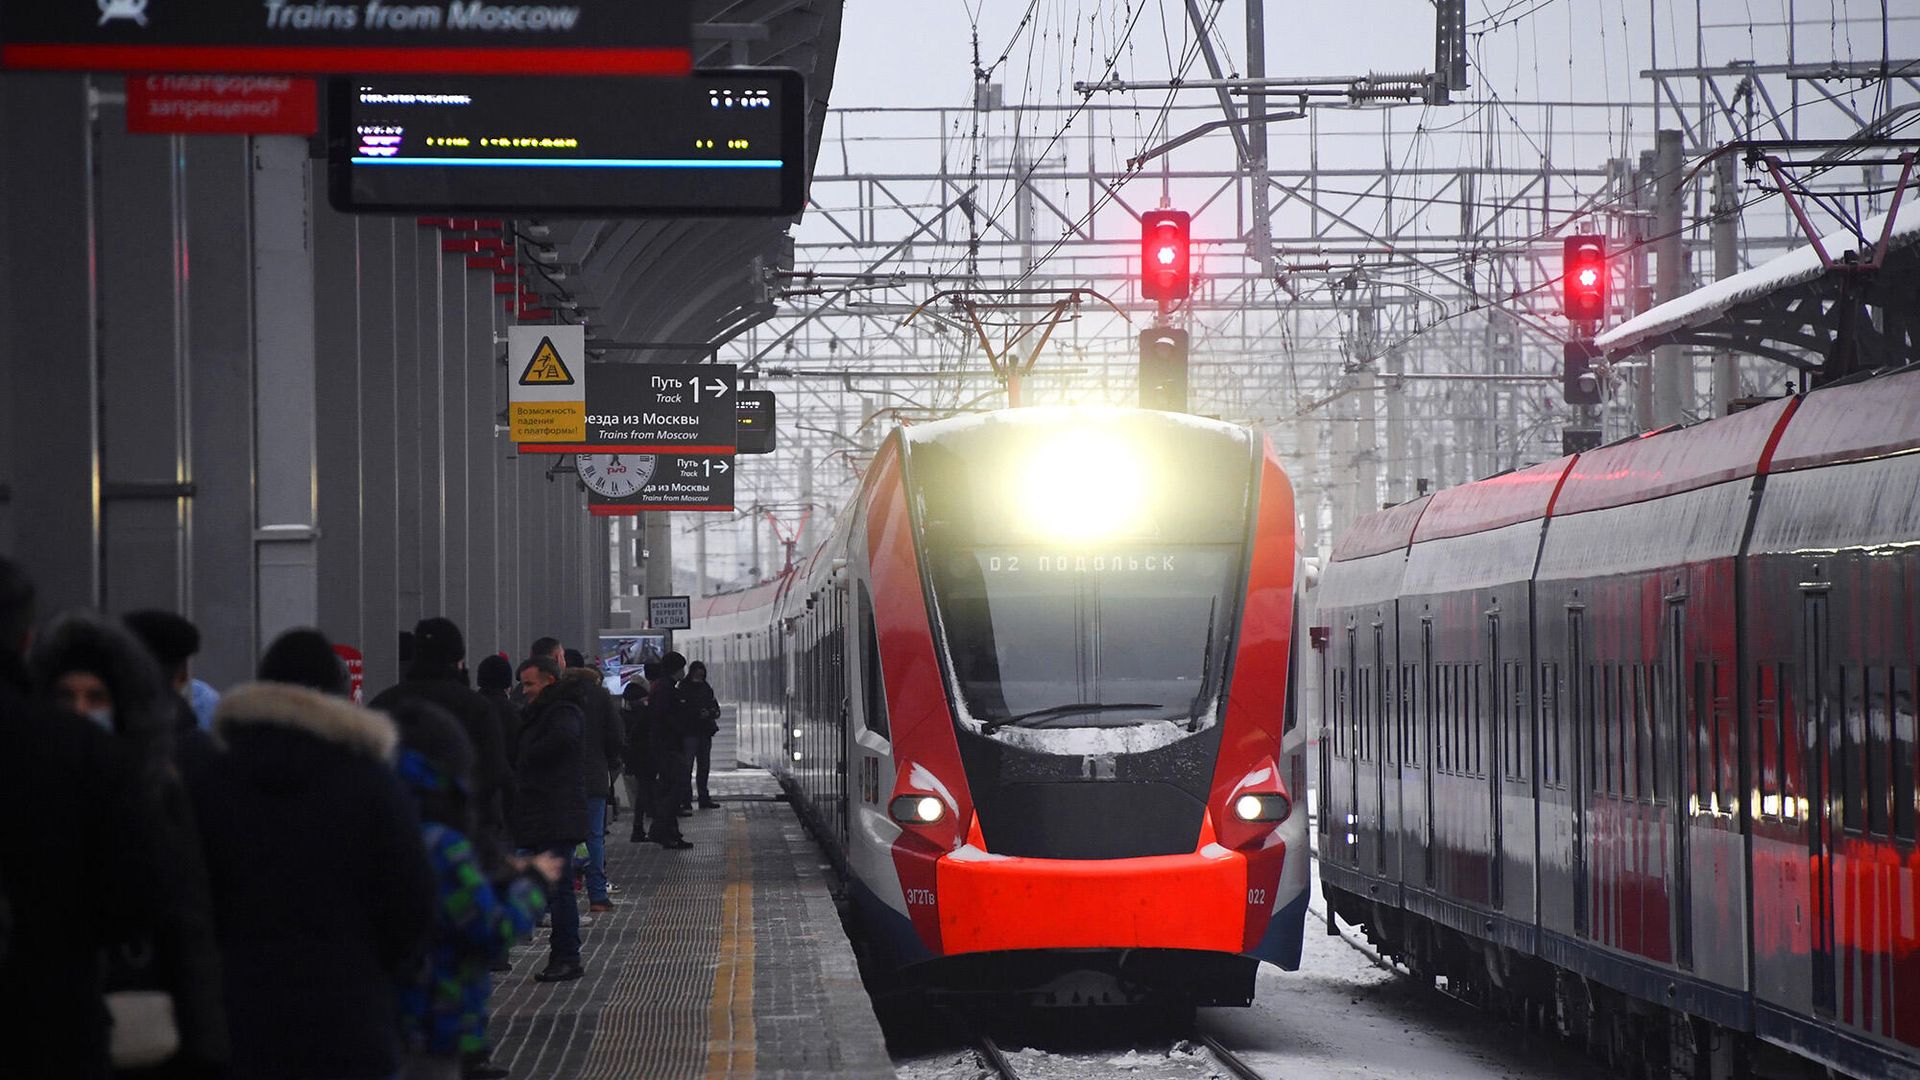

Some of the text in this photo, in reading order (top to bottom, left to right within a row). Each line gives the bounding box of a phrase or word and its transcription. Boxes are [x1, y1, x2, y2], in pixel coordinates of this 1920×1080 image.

[264, 0, 579, 29] Trains from Moscow
[651, 376, 700, 403] Путь 1
[656, 393, 682, 403] Track
[517, 407, 577, 415] Возможность
[517, 418, 554, 426] падения
[584, 413, 699, 426] езда из Москвы
[524, 427, 578, 436] платформы!
[599, 430, 699, 441] Trains from Moscow
[677, 458, 710, 478] Путь 1
[680, 470, 698, 478] Track
[658, 484, 670, 492] из
[671, 483, 710, 492] Москвы
[662, 494, 680, 502] from
[990, 555, 1175, 573] D2 ПОДОЛЬСК
[1247, 888, 1265, 905] 022
